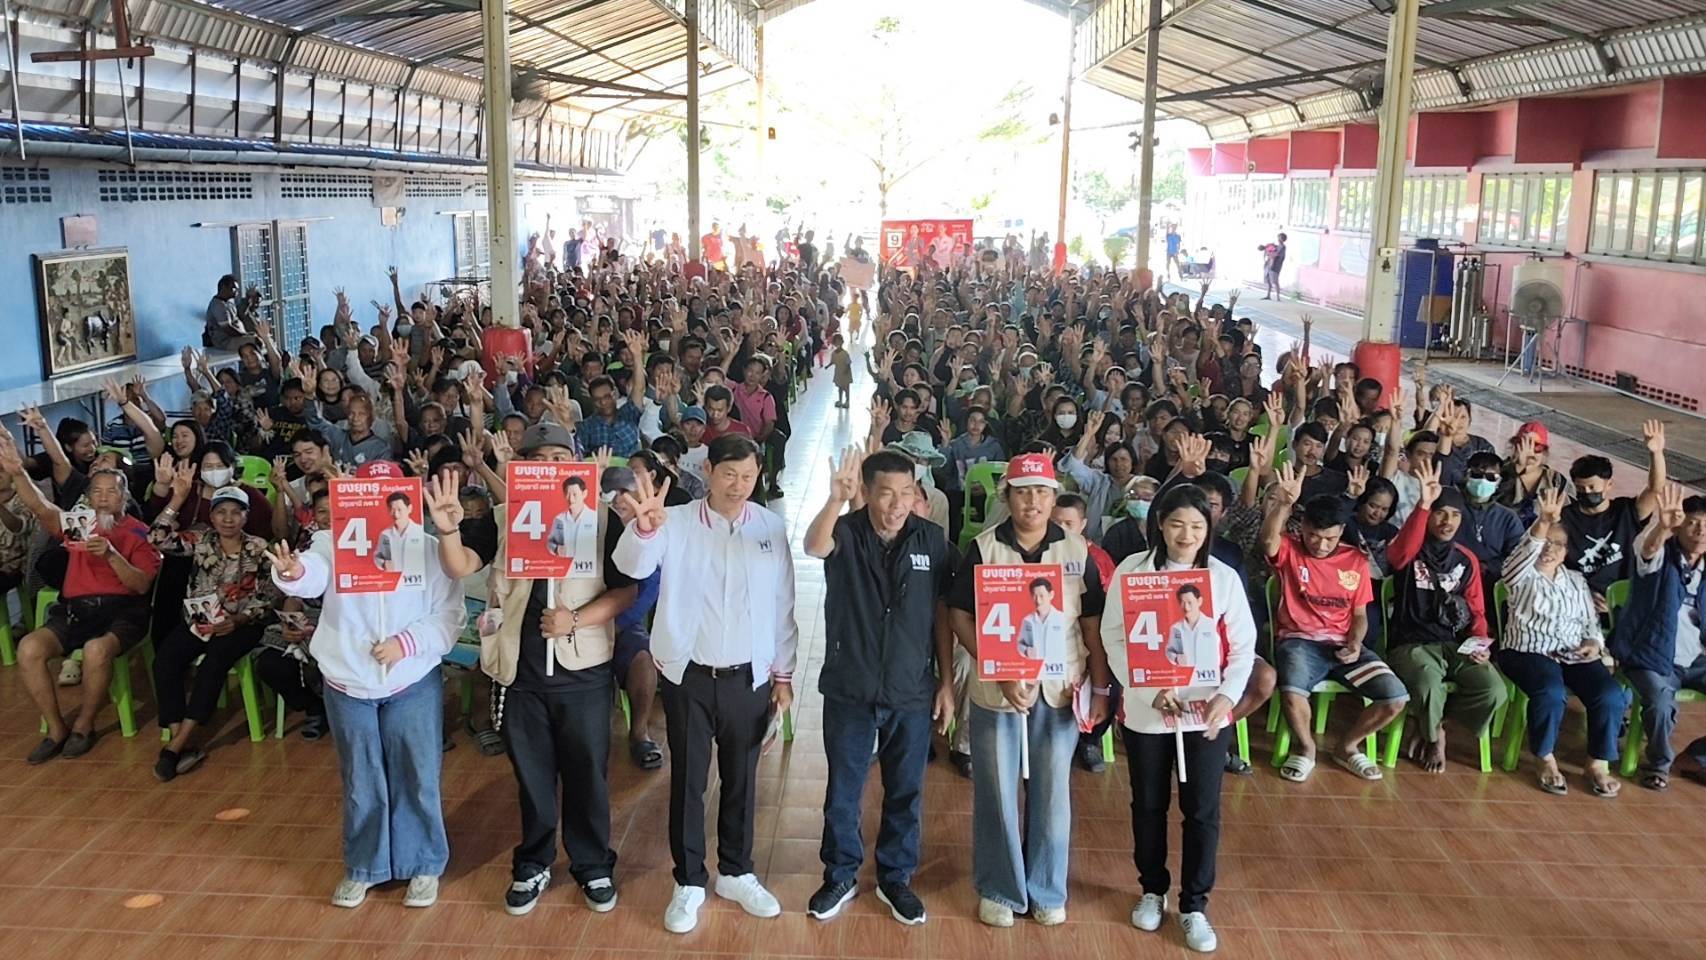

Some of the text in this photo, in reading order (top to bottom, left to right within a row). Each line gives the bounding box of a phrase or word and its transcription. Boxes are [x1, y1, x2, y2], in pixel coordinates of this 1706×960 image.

[890, 234, 900, 246] 9
[337, 518, 372, 556] 4
[512, 501, 546, 540] 4
[982, 603, 1016, 642] 4
[1129, 611, 1163, 650] 4
